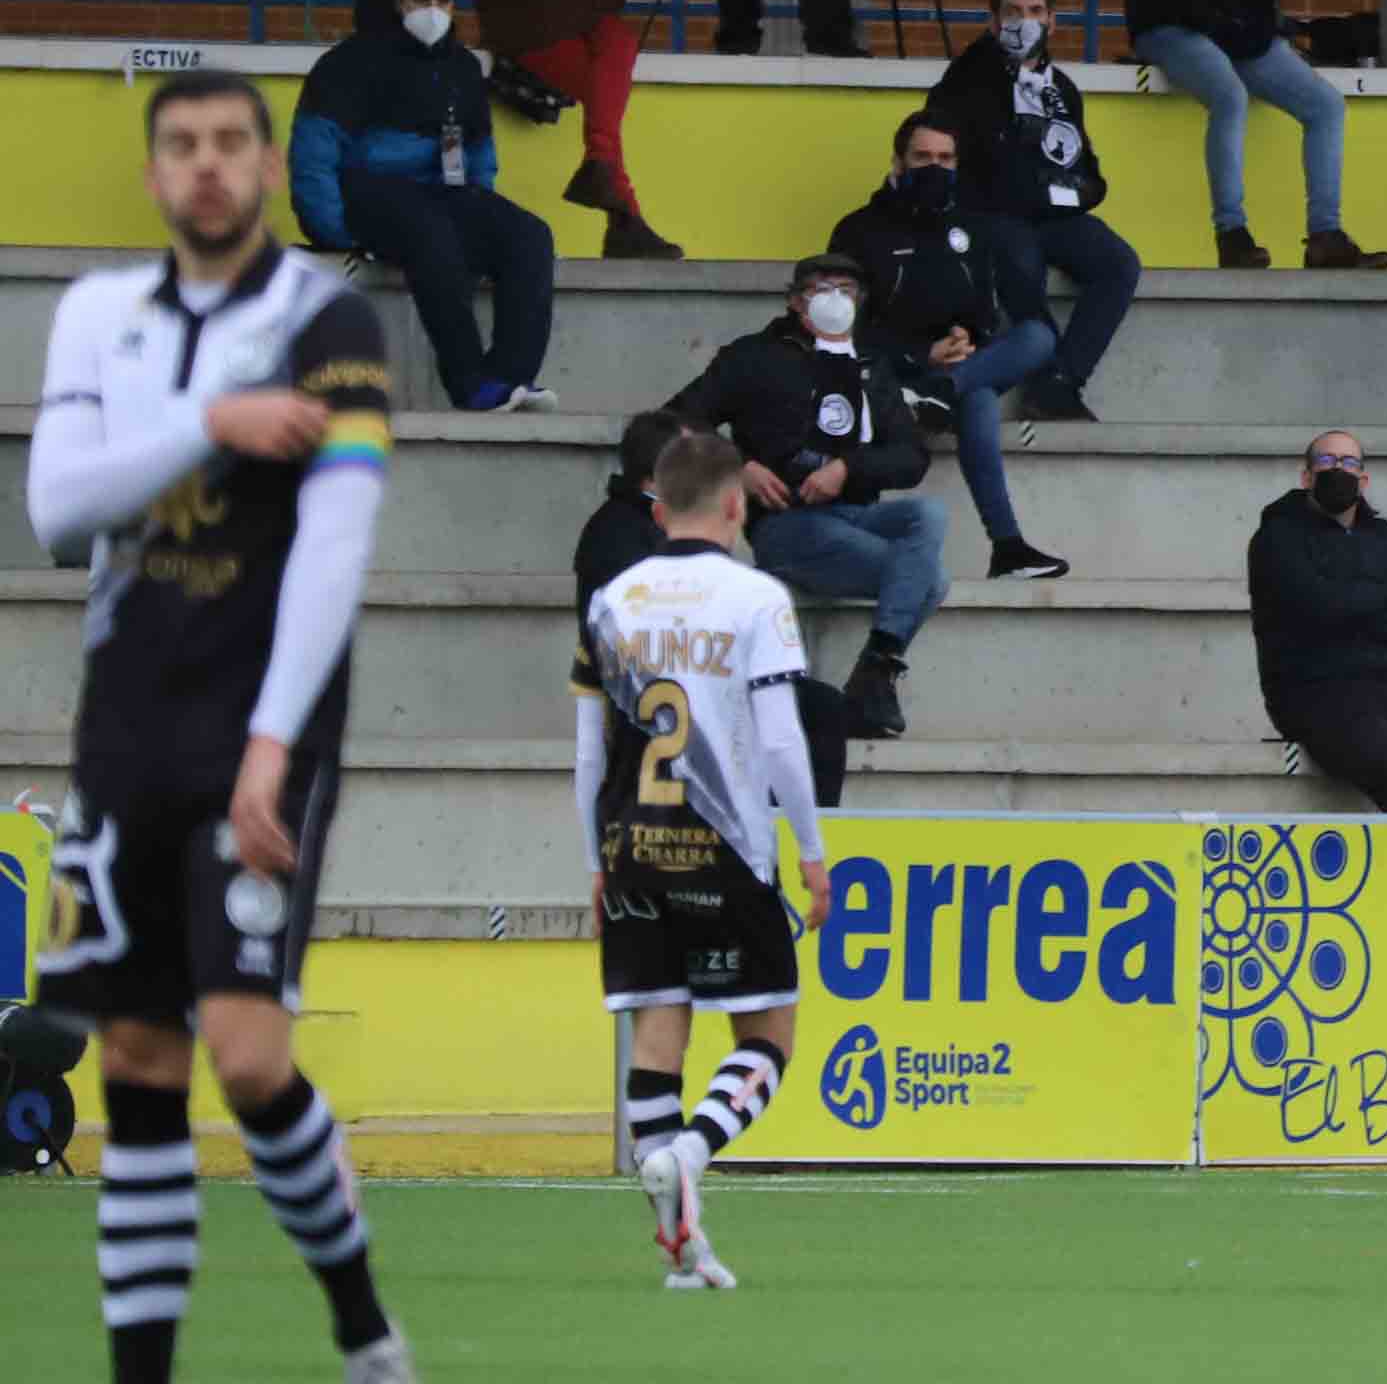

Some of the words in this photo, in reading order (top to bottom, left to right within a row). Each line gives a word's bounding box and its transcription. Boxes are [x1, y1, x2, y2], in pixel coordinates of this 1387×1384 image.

[638, 678, 690, 806] 2
[894, 1077, 970, 1112] Sport
[1281, 1057, 1345, 1143] El
